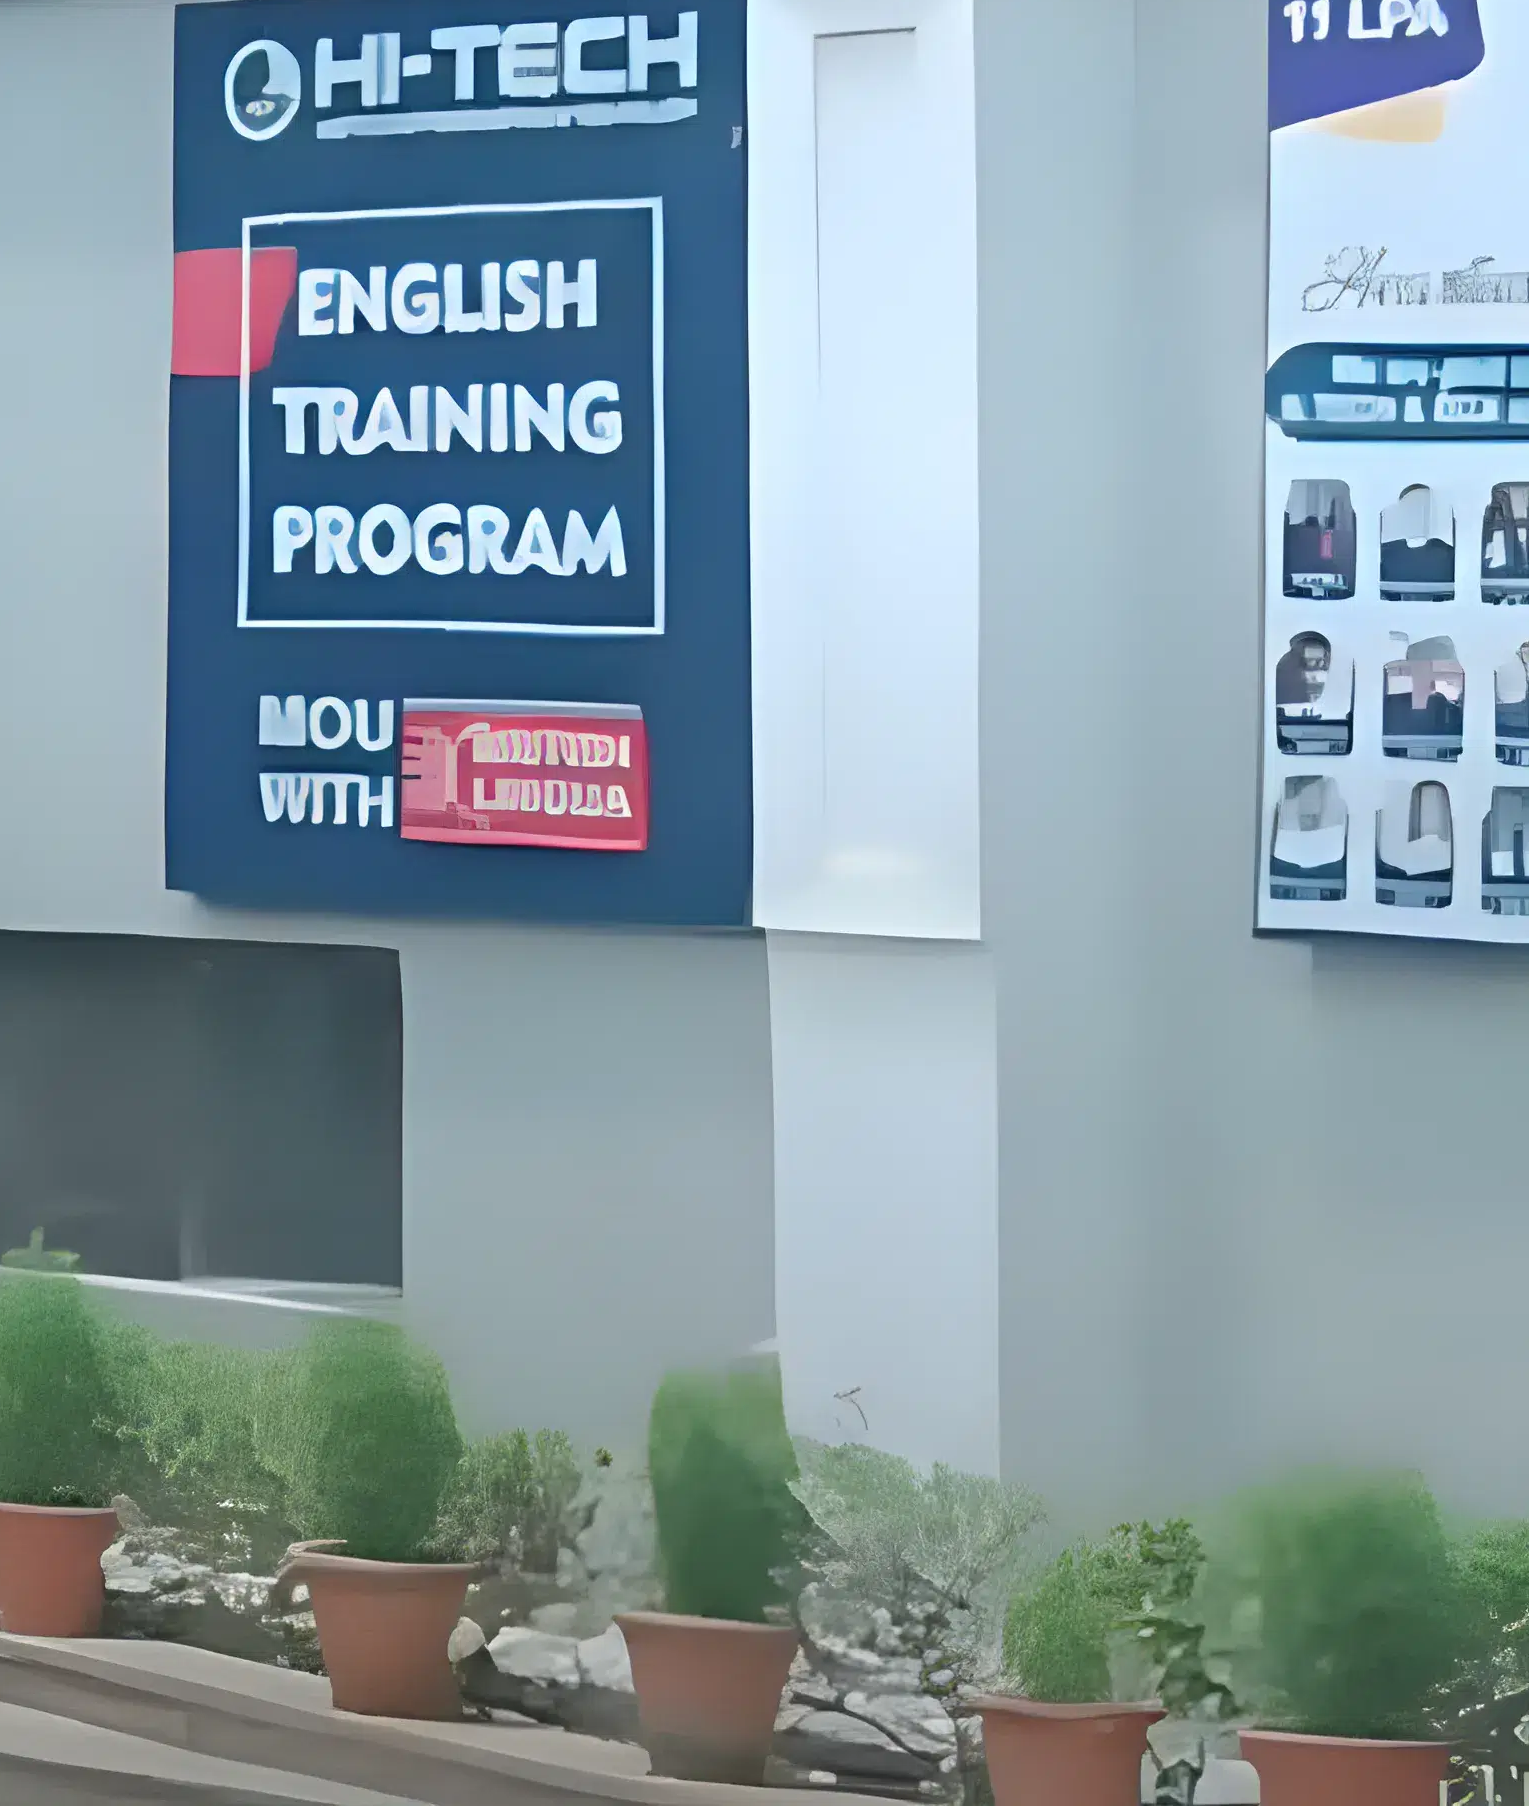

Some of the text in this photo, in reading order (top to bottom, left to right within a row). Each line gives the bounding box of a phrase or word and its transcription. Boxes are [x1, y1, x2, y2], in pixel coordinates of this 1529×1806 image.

[314, 10, 699, 108] HI-TECH
[297, 258, 598, 337] ENGLISH
[272, 379, 624, 456] TRAINING
[272, 502, 628, 578] PROGRAM
[258, 694, 394, 752] MOU
[258, 771, 394, 829] WITH
